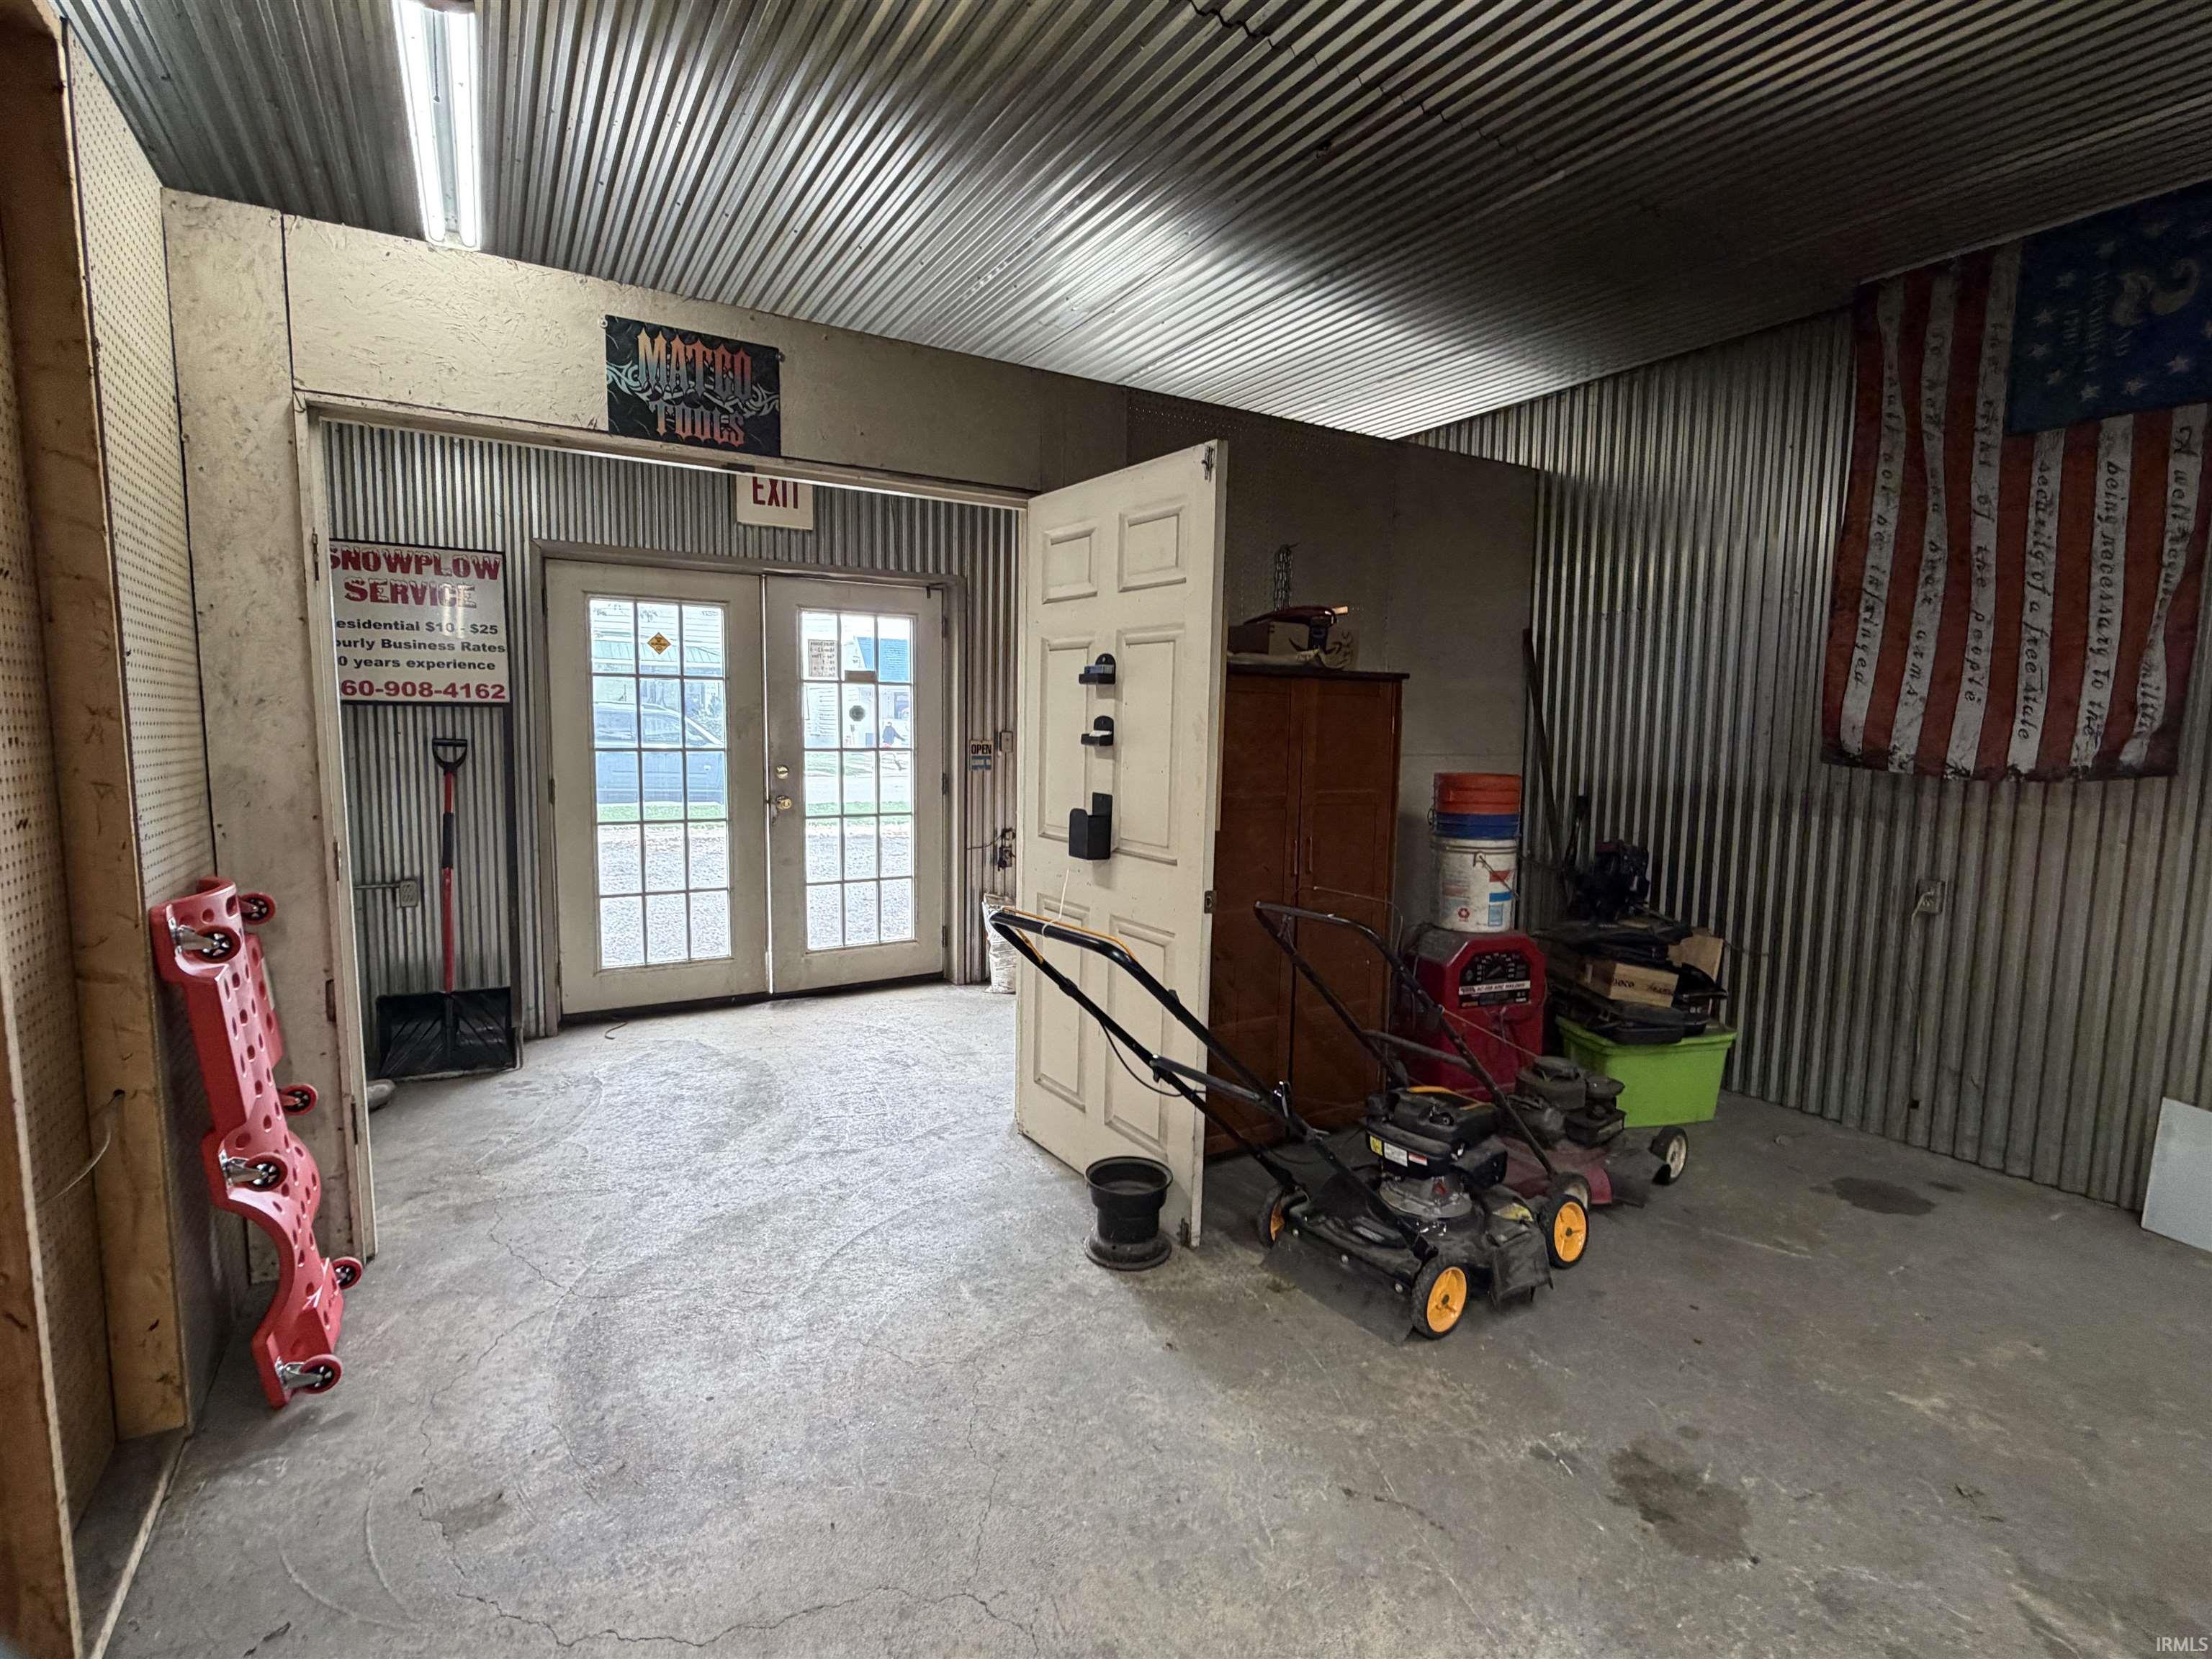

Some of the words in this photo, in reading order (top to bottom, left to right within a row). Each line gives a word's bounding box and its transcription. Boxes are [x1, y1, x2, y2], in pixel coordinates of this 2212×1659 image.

[637, 327, 752, 401] MATCO
[650, 399, 745, 448] TOOLS
[2098, 461, 2126, 525] being
[2029, 461, 2054, 567] security
[344, 577, 477, 609] SERVICE
[2029, 572, 2051, 596] of
[2090, 532, 2116, 657] necessary
[336, 619, 420, 631] esidential
[426, 621, 455, 633] $10
[470, 624, 498, 634] $25
[381, 639, 456, 651] Business
[461, 642, 505, 653] Rates
[338, 656, 347, 666] 0
[354, 658, 400, 669] years
[406, 659, 496, 670] experience
[1963, 611, 1988, 703] people
[2023, 622, 2048, 674] free
[341, 680, 506, 700] 60-908-4162
[971, 744, 992, 755] OPEN
